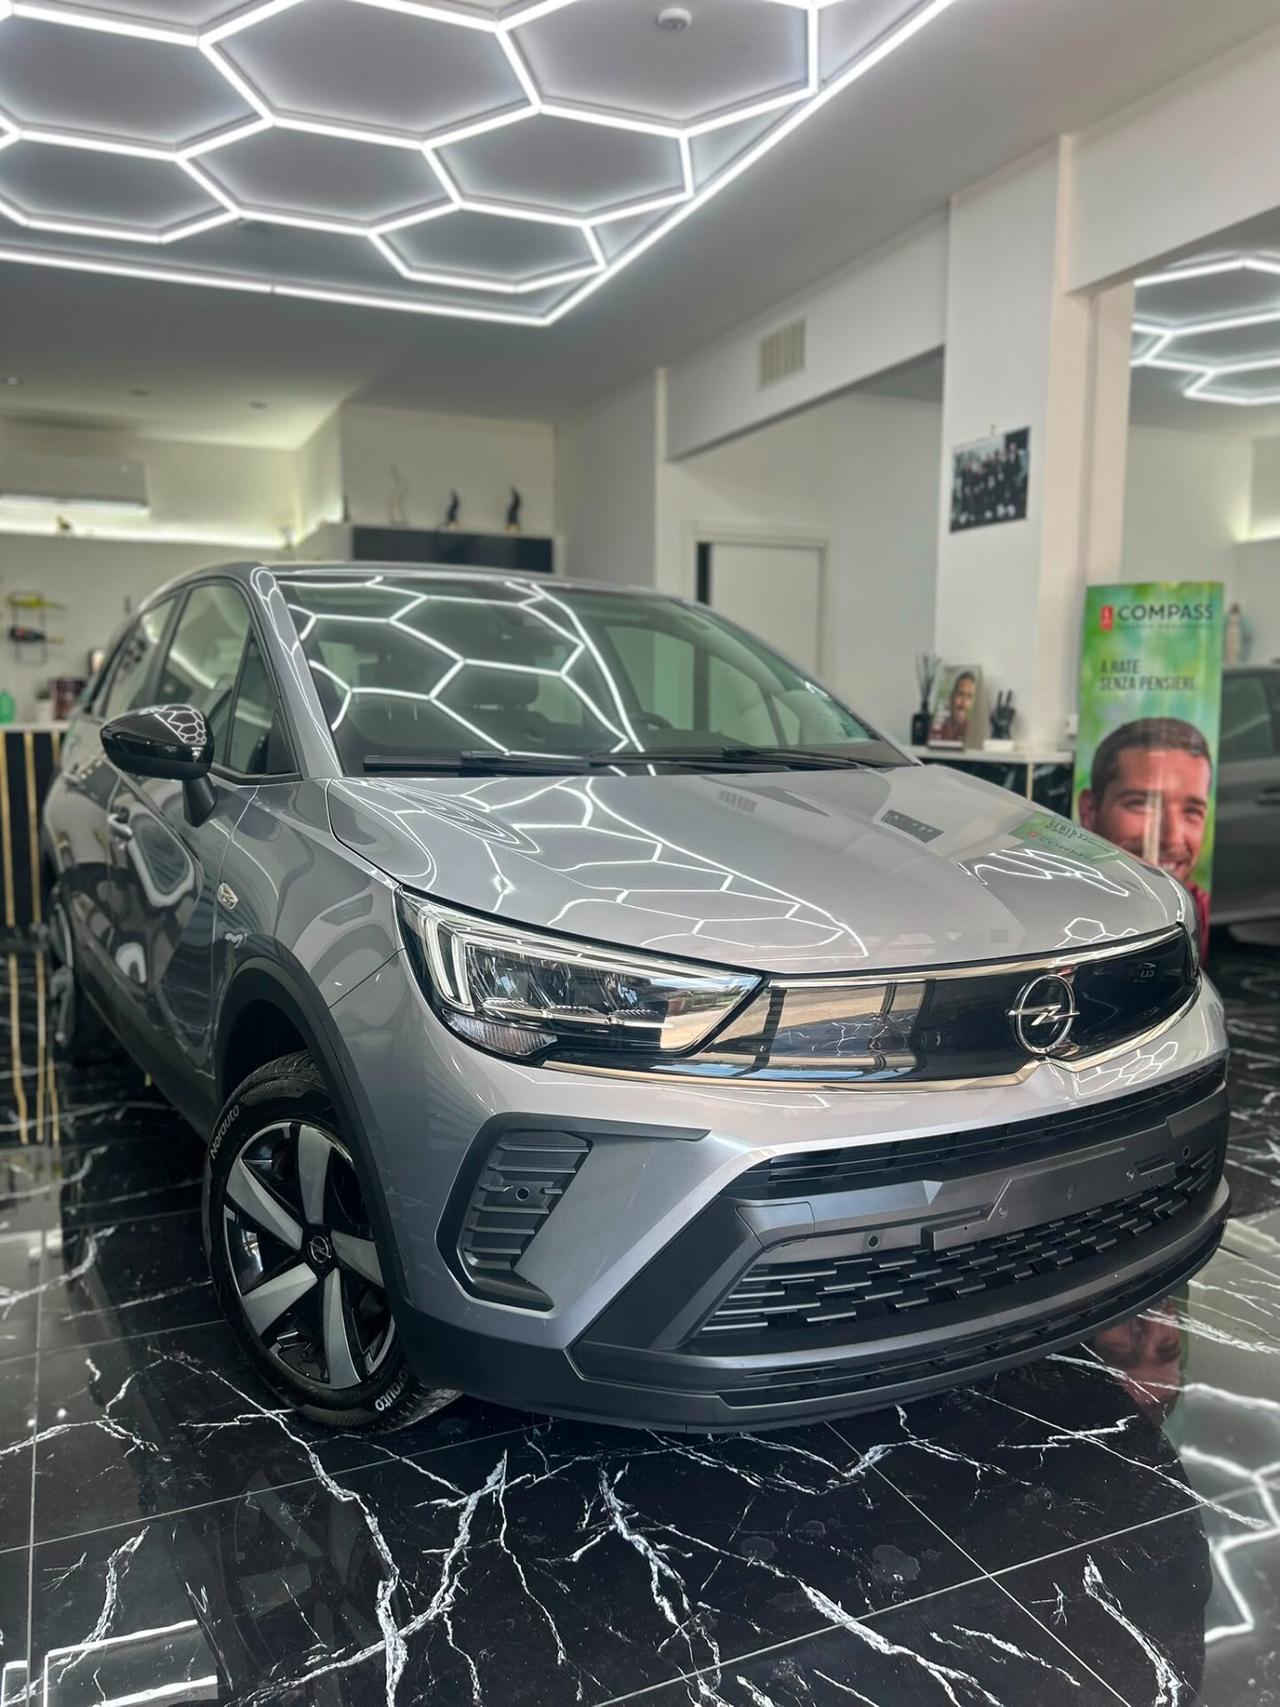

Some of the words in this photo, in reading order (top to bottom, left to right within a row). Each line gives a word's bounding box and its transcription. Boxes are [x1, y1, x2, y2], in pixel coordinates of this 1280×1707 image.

[1118, 604, 1214, 621] COMPASS
[1100, 659, 1108, 673] A
[1111, 659, 1139, 673] RATE
[1100, 676, 1135, 690] SENZA
[210, 1105, 239, 1160] Norauto
[374, 1369, 408, 1412] orauto
